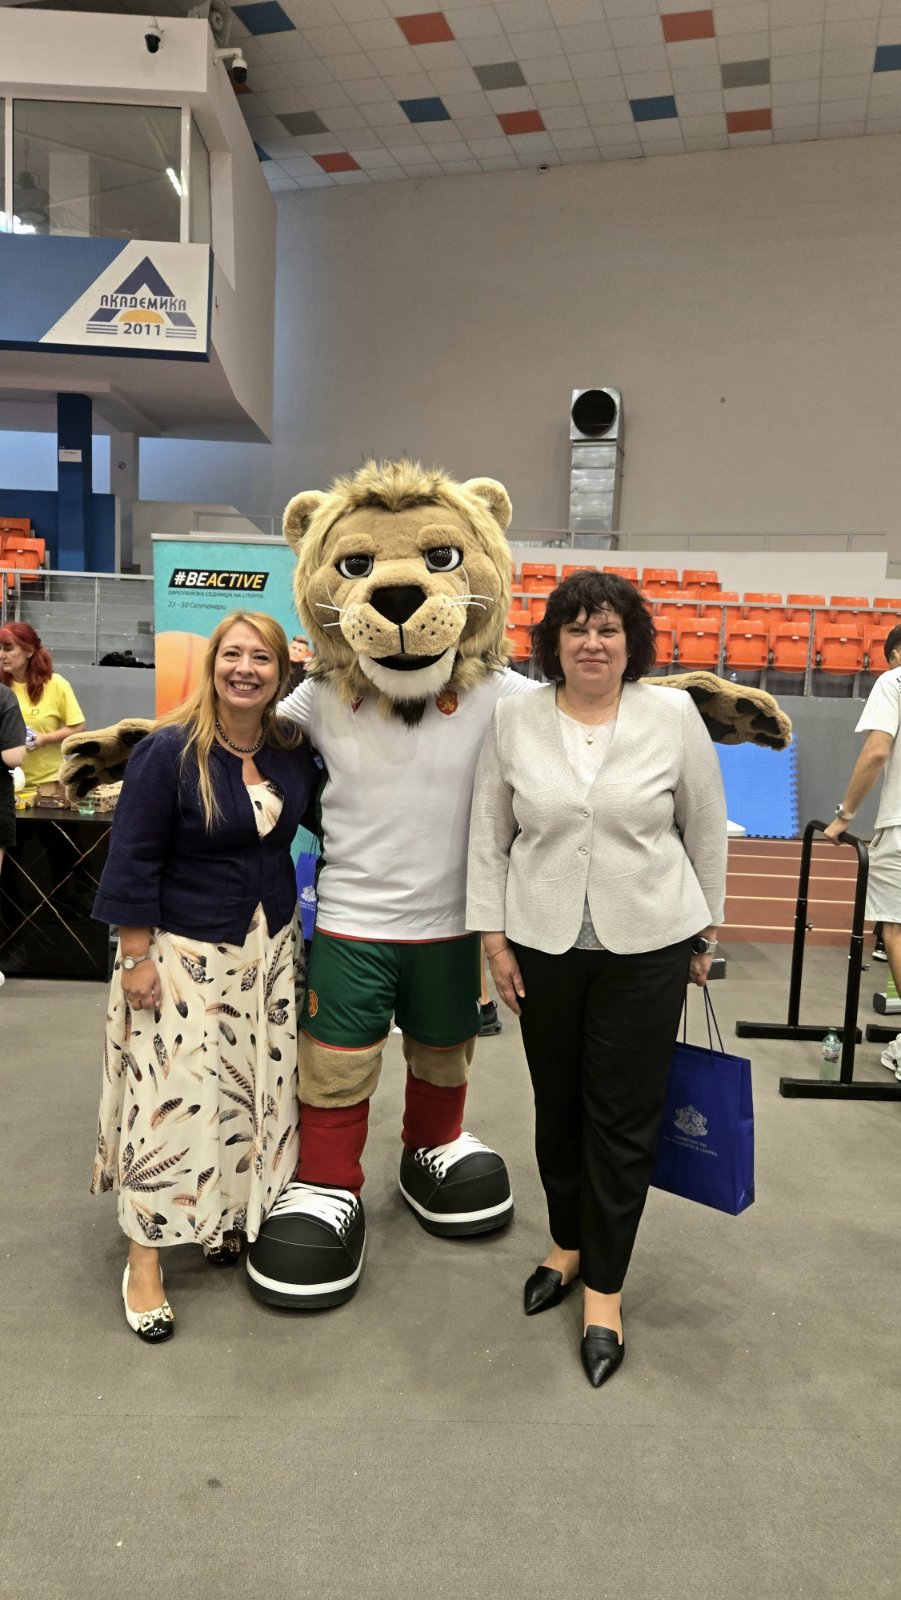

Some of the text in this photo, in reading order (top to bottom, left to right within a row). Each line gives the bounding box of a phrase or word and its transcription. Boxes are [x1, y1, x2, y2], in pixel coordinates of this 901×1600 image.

[100, 294, 187, 312] АКАДЕМИКА
[123, 322, 161, 336] 2011
[174, 571, 265, 589] #BEACTIVE
[181, 601, 189, 609] 30
[189, 602, 227, 611] Септември
